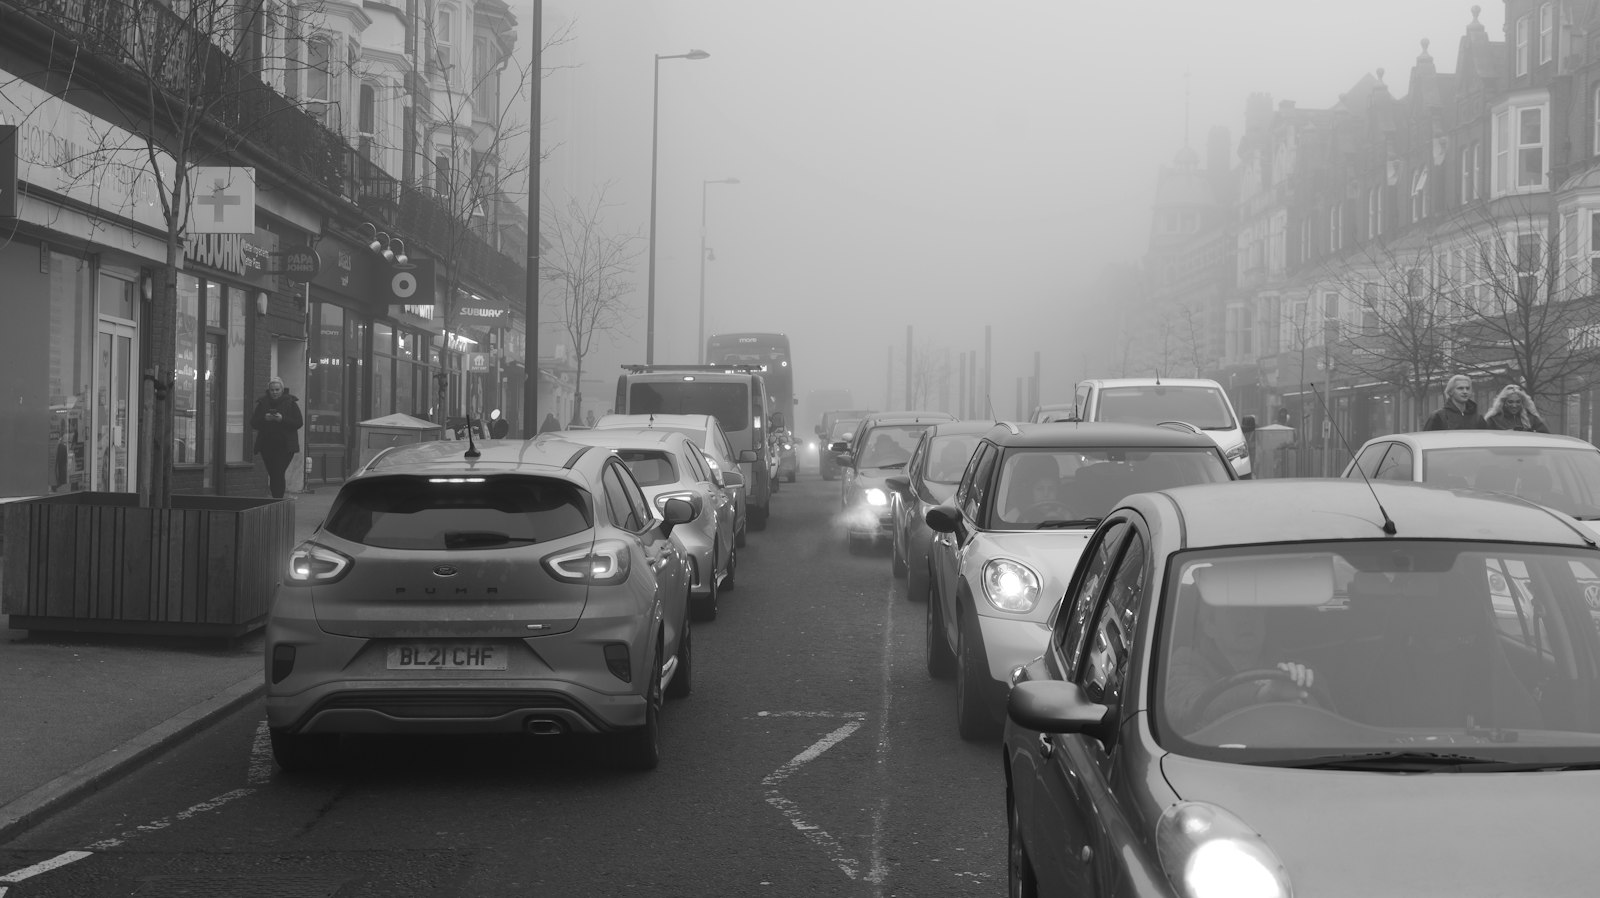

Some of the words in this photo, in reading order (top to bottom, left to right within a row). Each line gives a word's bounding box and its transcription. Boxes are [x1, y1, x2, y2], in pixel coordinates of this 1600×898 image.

[287, 253, 313, 264] PAPA
[286, 263, 314, 272] JOHNS
[459, 307, 504, 318] SUBWAY
[400, 649, 446, 666] BL21
[452, 648, 494, 666] CHF
